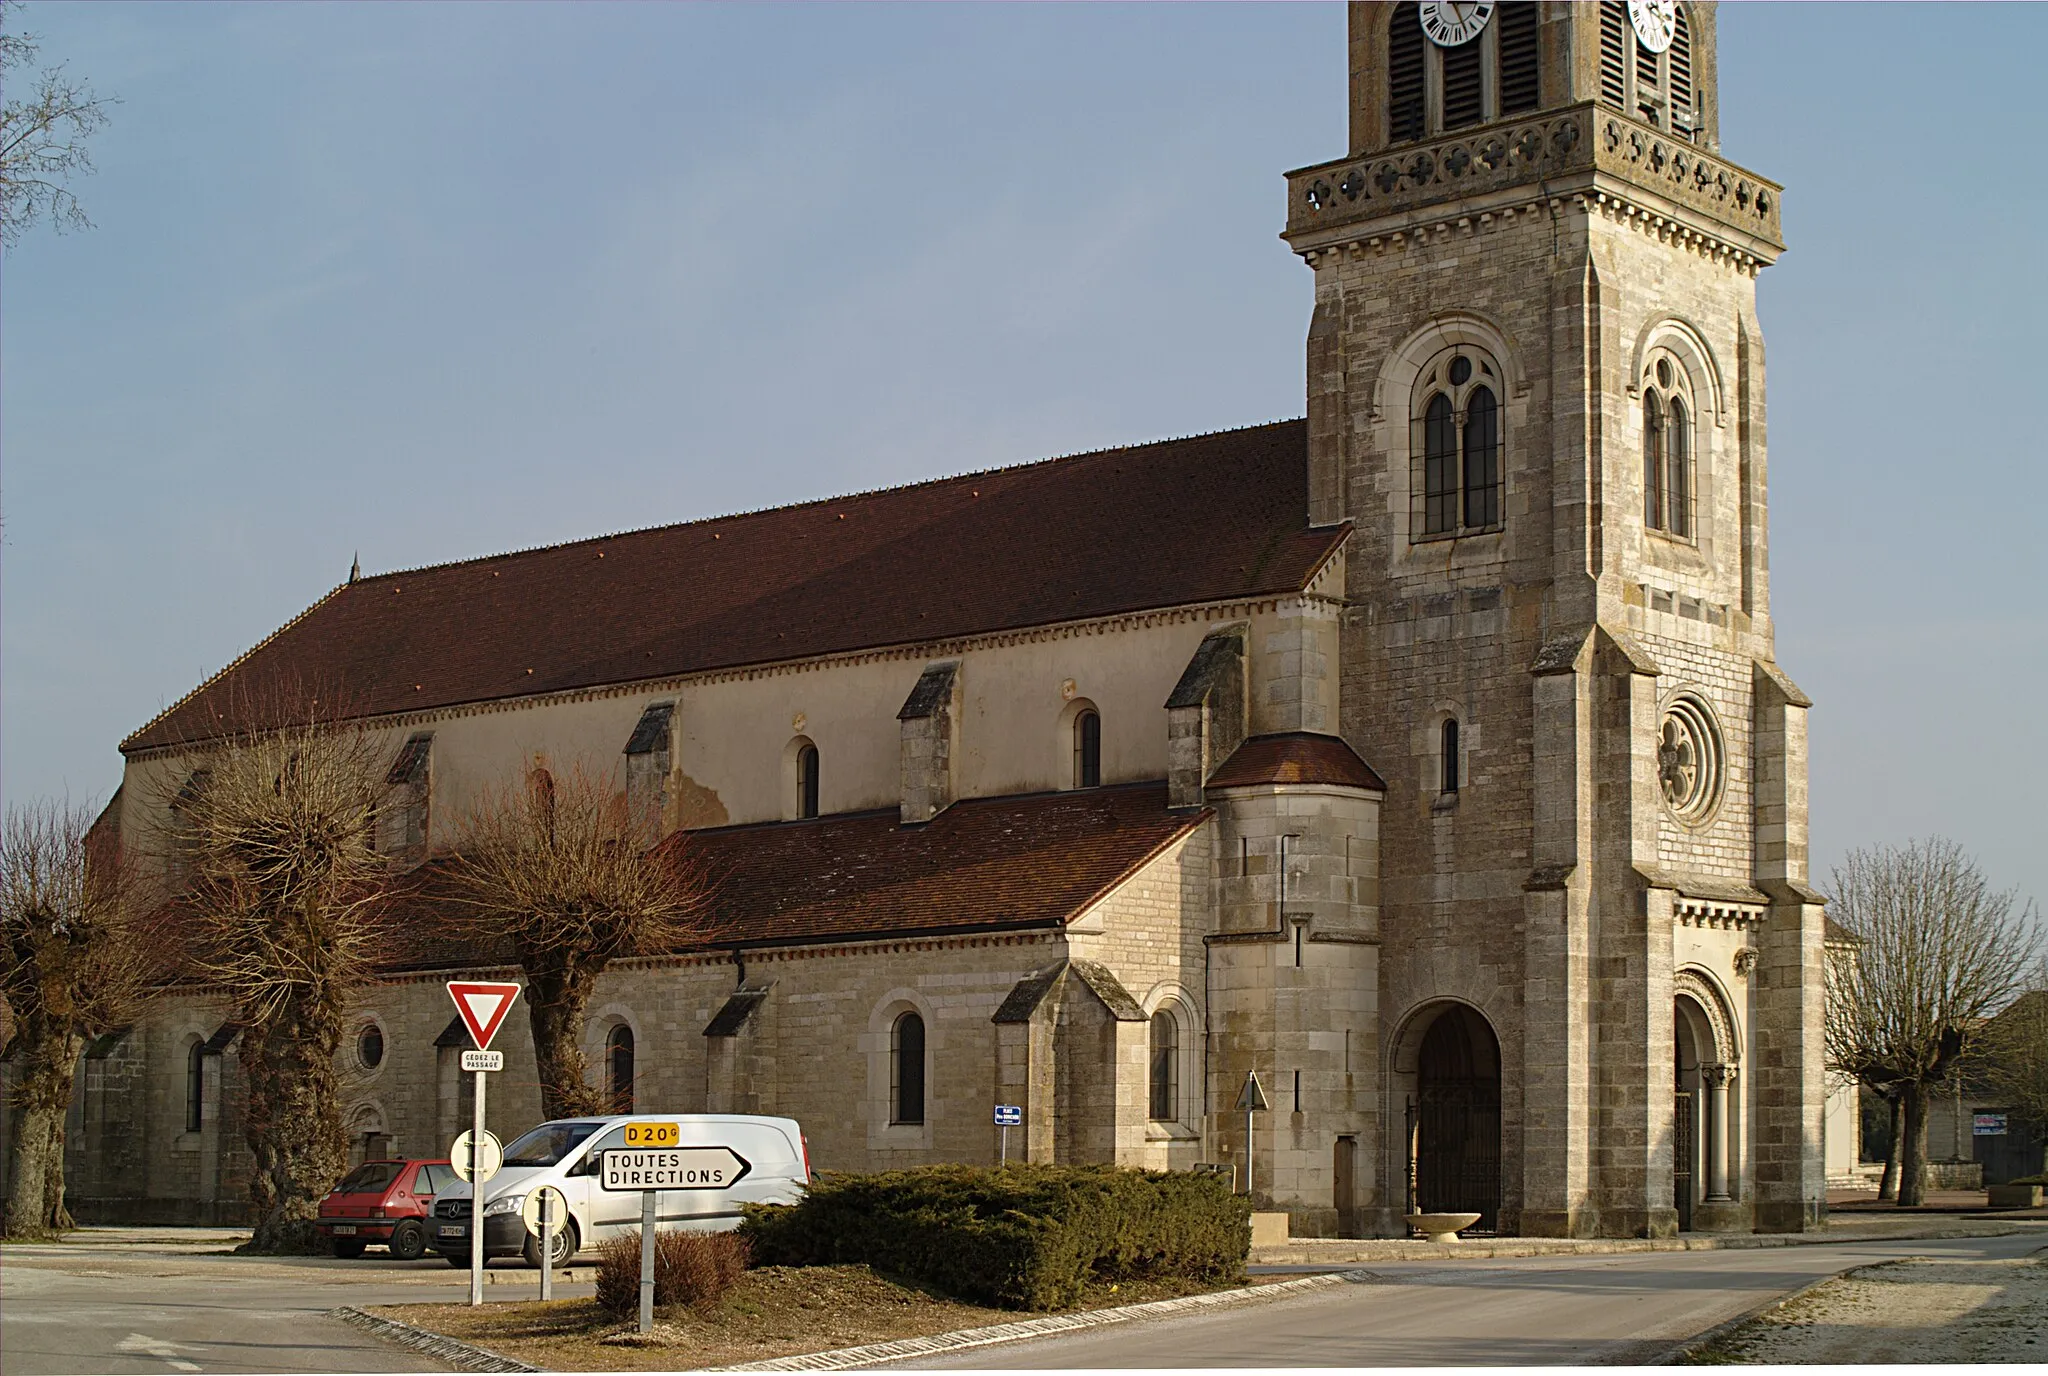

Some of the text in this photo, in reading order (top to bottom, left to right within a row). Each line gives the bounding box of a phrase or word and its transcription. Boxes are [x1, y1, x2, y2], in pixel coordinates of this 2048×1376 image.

[465, 1053, 488, 1061] CÉDEZ
[628, 1128, 638, 1141] D
[610, 1154, 680, 1168] TOUTES
[610, 1169, 723, 1184] DIRECTIONS
